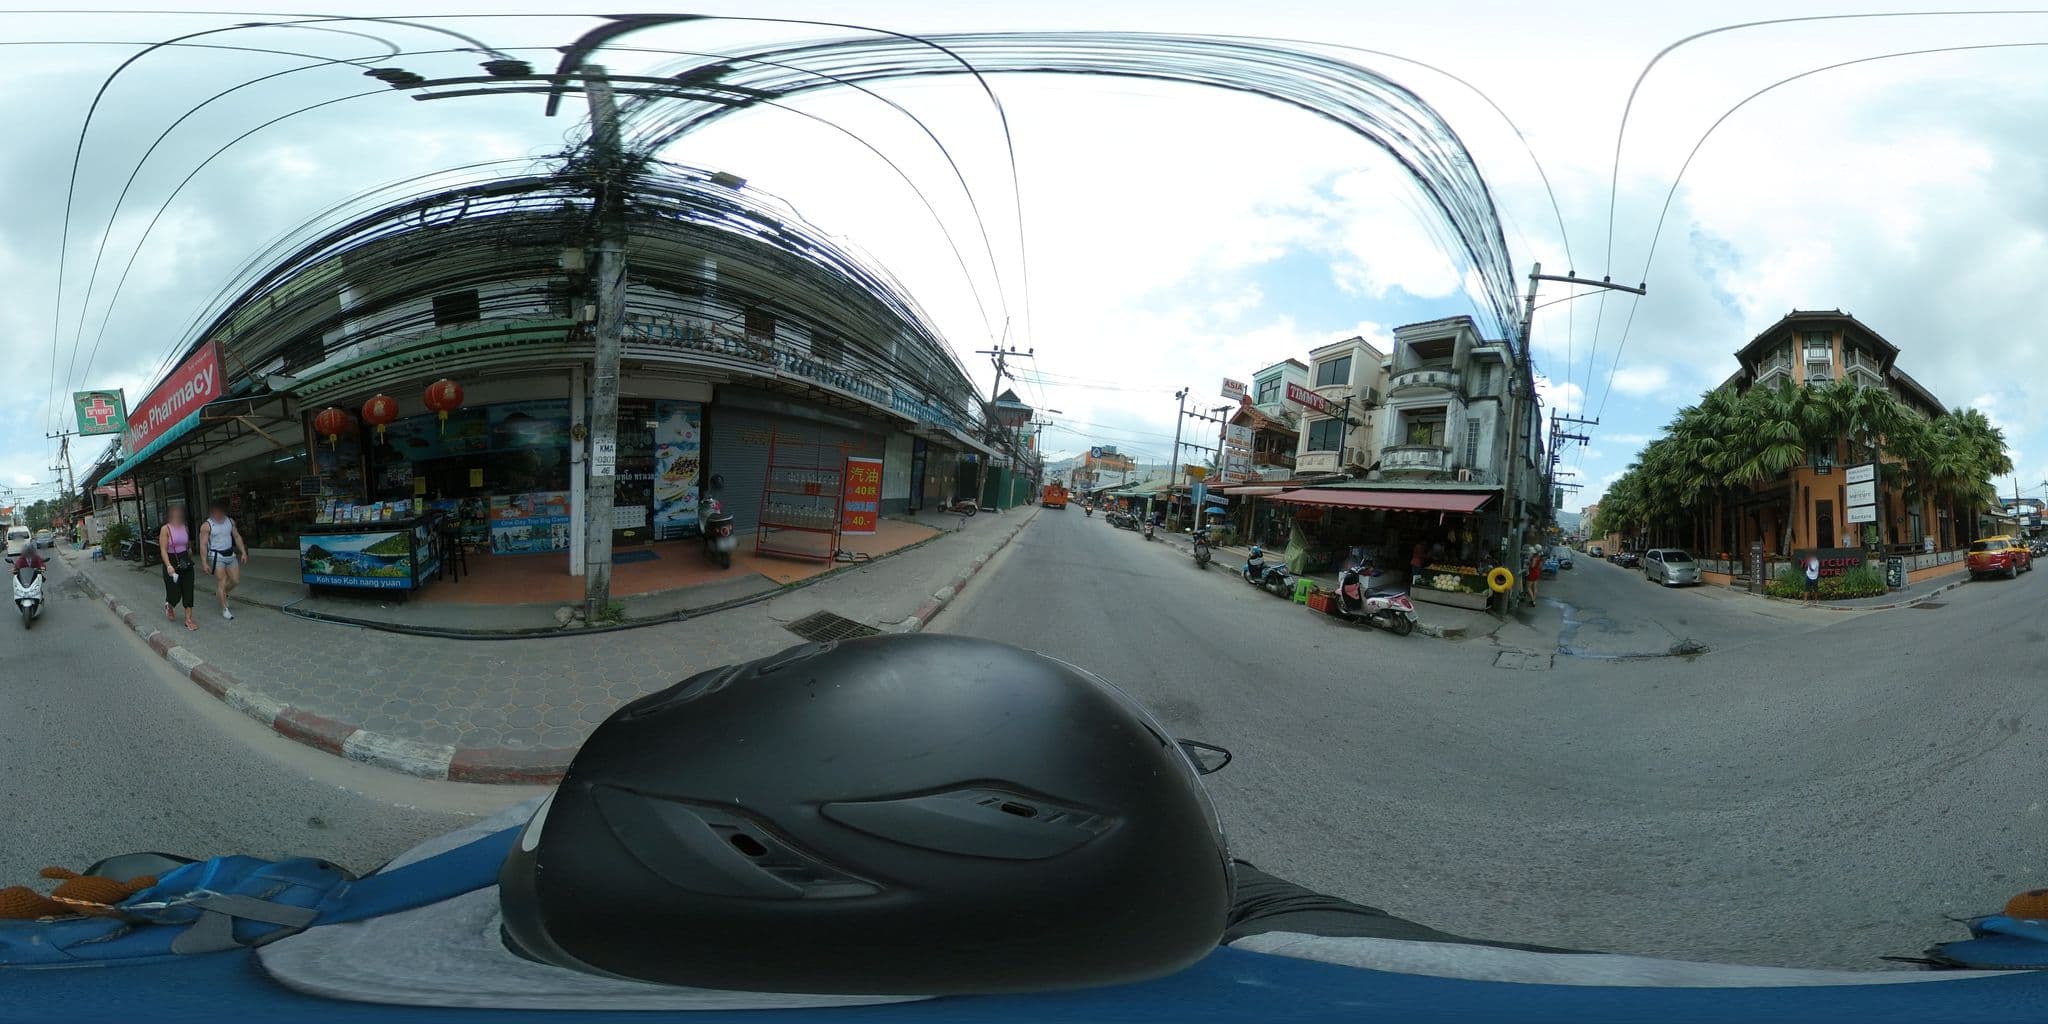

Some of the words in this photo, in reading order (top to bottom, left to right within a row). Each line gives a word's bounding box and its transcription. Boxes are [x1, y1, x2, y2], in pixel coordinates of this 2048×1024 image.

[1224, 380, 1243, 390] ASIA
[131, 420, 149, 443] Nice
[149, 364, 214, 430] Pharmacy
[1290, 385, 1325, 409] TIMMY'S
[316, 576, 330, 584] Koh
[330, 576, 342, 584] tao
[344, 577, 358, 585] Koh
[360, 579, 379, 588] nang
[381, 579, 401, 588] yuan
